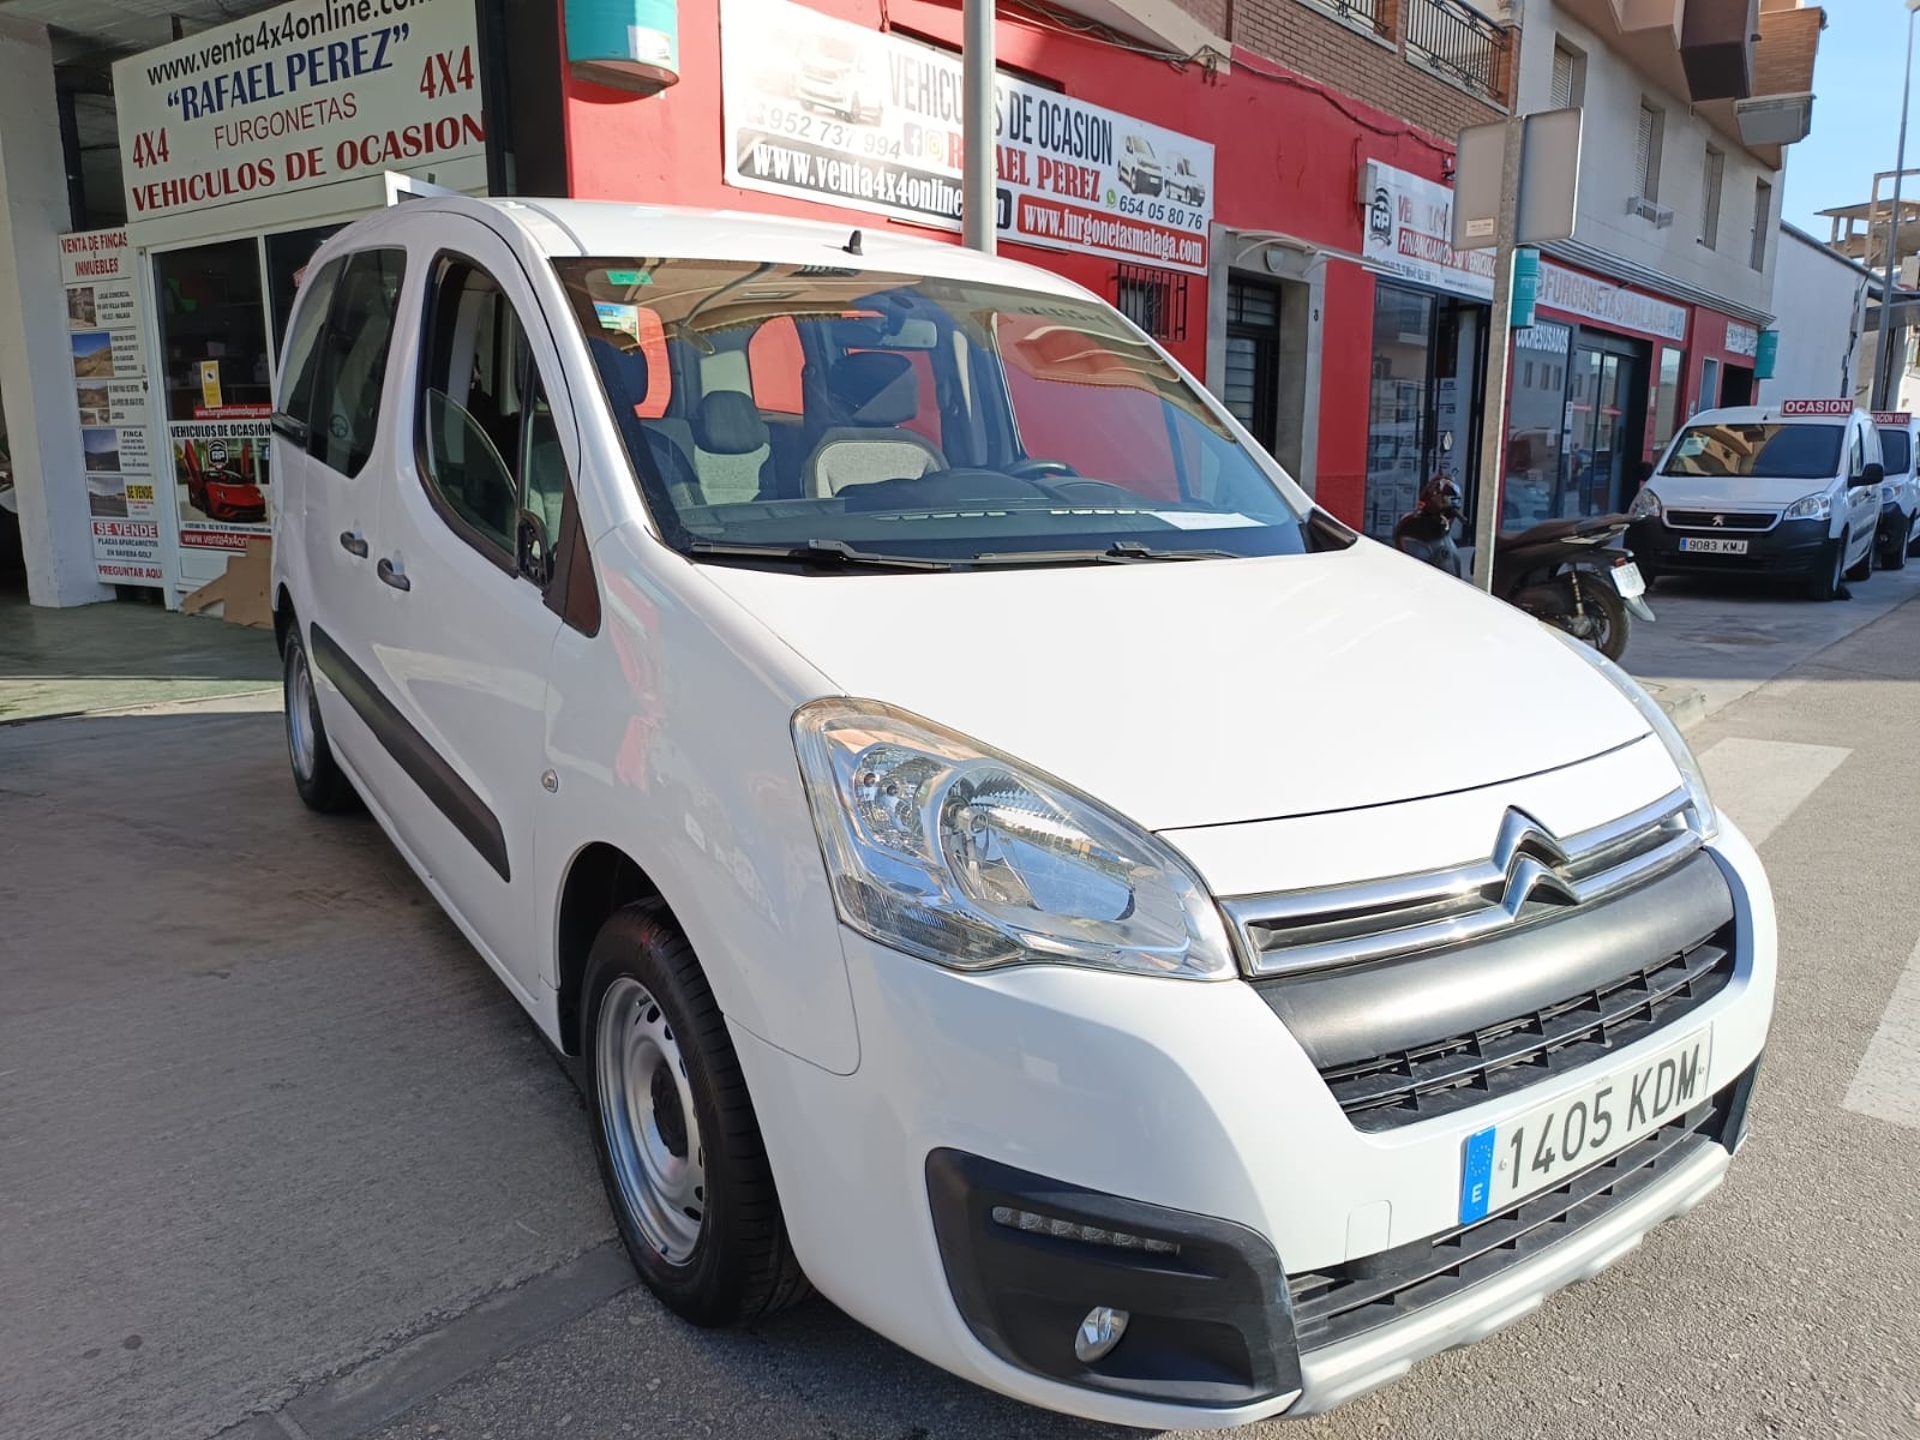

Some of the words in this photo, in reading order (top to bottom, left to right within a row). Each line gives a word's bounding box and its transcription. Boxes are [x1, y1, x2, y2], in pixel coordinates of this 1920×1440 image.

[146, 0, 432, 86] www.venta4x4online.co
[419, 45, 475, 99] 4X4
[214, 92, 358, 149] FURGONETAS
[888, 50, 1004, 136] VEHICUS
[1009, 90, 1033, 145] DE
[1038, 99, 1113, 166] OCASION
[132, 127, 170, 169] 4X4
[769, 107, 813, 139] 952
[863, 132, 903, 161] 994
[132, 158, 276, 212] VEHICULOS
[286, 147, 327, 182] DE
[336, 113, 487, 171] OCASION
[753, 143, 1005, 224] www.venta4x4online
[946, 131, 1031, 187] RAEL
[1036, 155, 1102, 203] PEREZ
[1023, 203, 1203, 265] www.furgonetasmalaga.com
[1119, 195, 1144, 217] 654
[1147, 204, 1165, 221] 05
[1168, 208, 1184, 225] 80
[1188, 212, 1204, 230] 76
[60, 237, 88, 254] VENTA
[88, 235, 100, 251] DE
[100, 232, 128, 250] FINCAS
[75, 257, 119, 276] INMUEBLES
[1785, 401, 1851, 412] OCASION
[170, 425, 217, 438] VEHICULOS
[217, 425, 228, 436] DE
[97, 522, 113, 536] SE
[115, 523, 157, 537] VENDE
[1689, 539, 1718, 551] 9083
[1722, 541, 1745, 553] KMJ
[98, 565, 145, 578] PREGUNTAR
[1509, 1086, 1614, 1190] 1405
[1626, 1043, 1701, 1132] KDM
[1471, 1183, 1483, 1204] E
